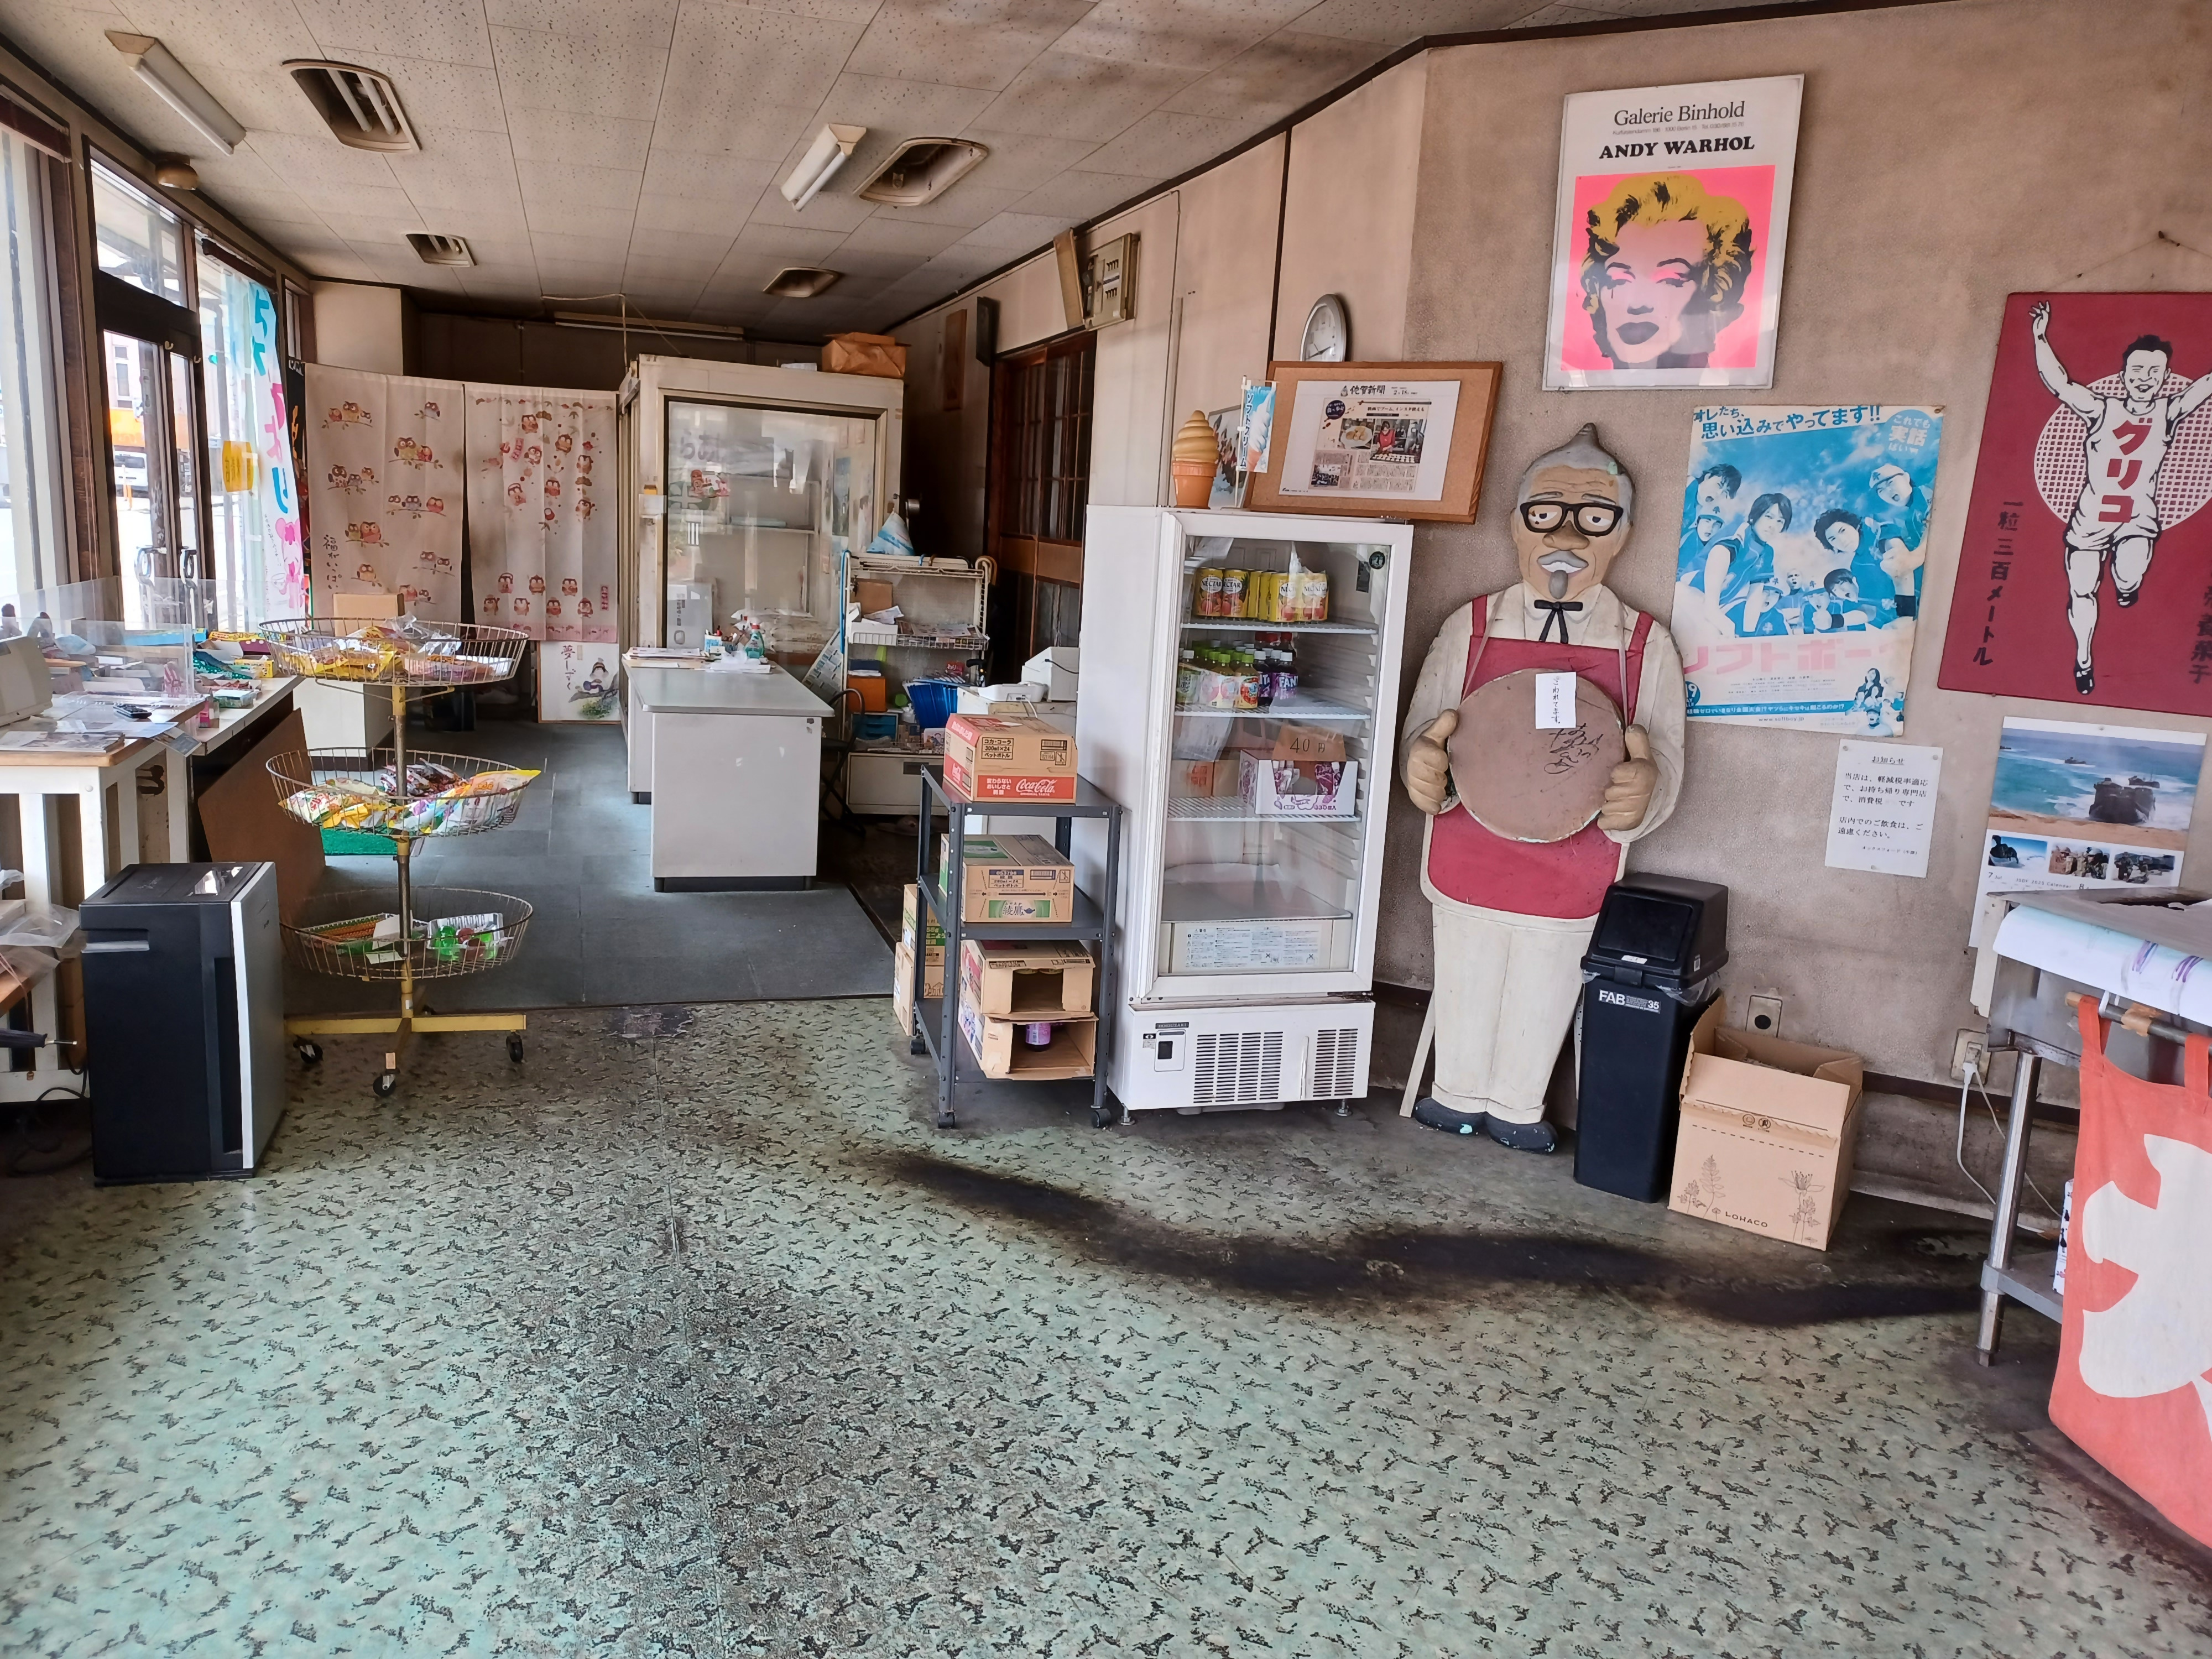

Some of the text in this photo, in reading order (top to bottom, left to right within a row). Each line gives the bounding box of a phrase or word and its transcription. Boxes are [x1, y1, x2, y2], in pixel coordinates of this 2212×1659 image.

[1614, 101, 1745, 126] Galerie Binhold
[1599, 136, 1755, 159] ANDY WARHOL
[1240, 393, 1254, 467] ソフトクリーム
[1893, 415, 1930, 429] これでも
[2098, 418, 2153, 523] グリコ
[1973, 501, 2024, 666] 一粒三百メートル
[1290, 738, 1326, 753] 40 円
[1872, 756, 1905, 764] お知らせ
[1016, 779, 1057, 793] Coca-Cola
[1599, 990, 1625, 1005] FAB
[1647, 1000, 1660, 1009] 35
[1725, 1211, 1768, 1228] LOHACO
